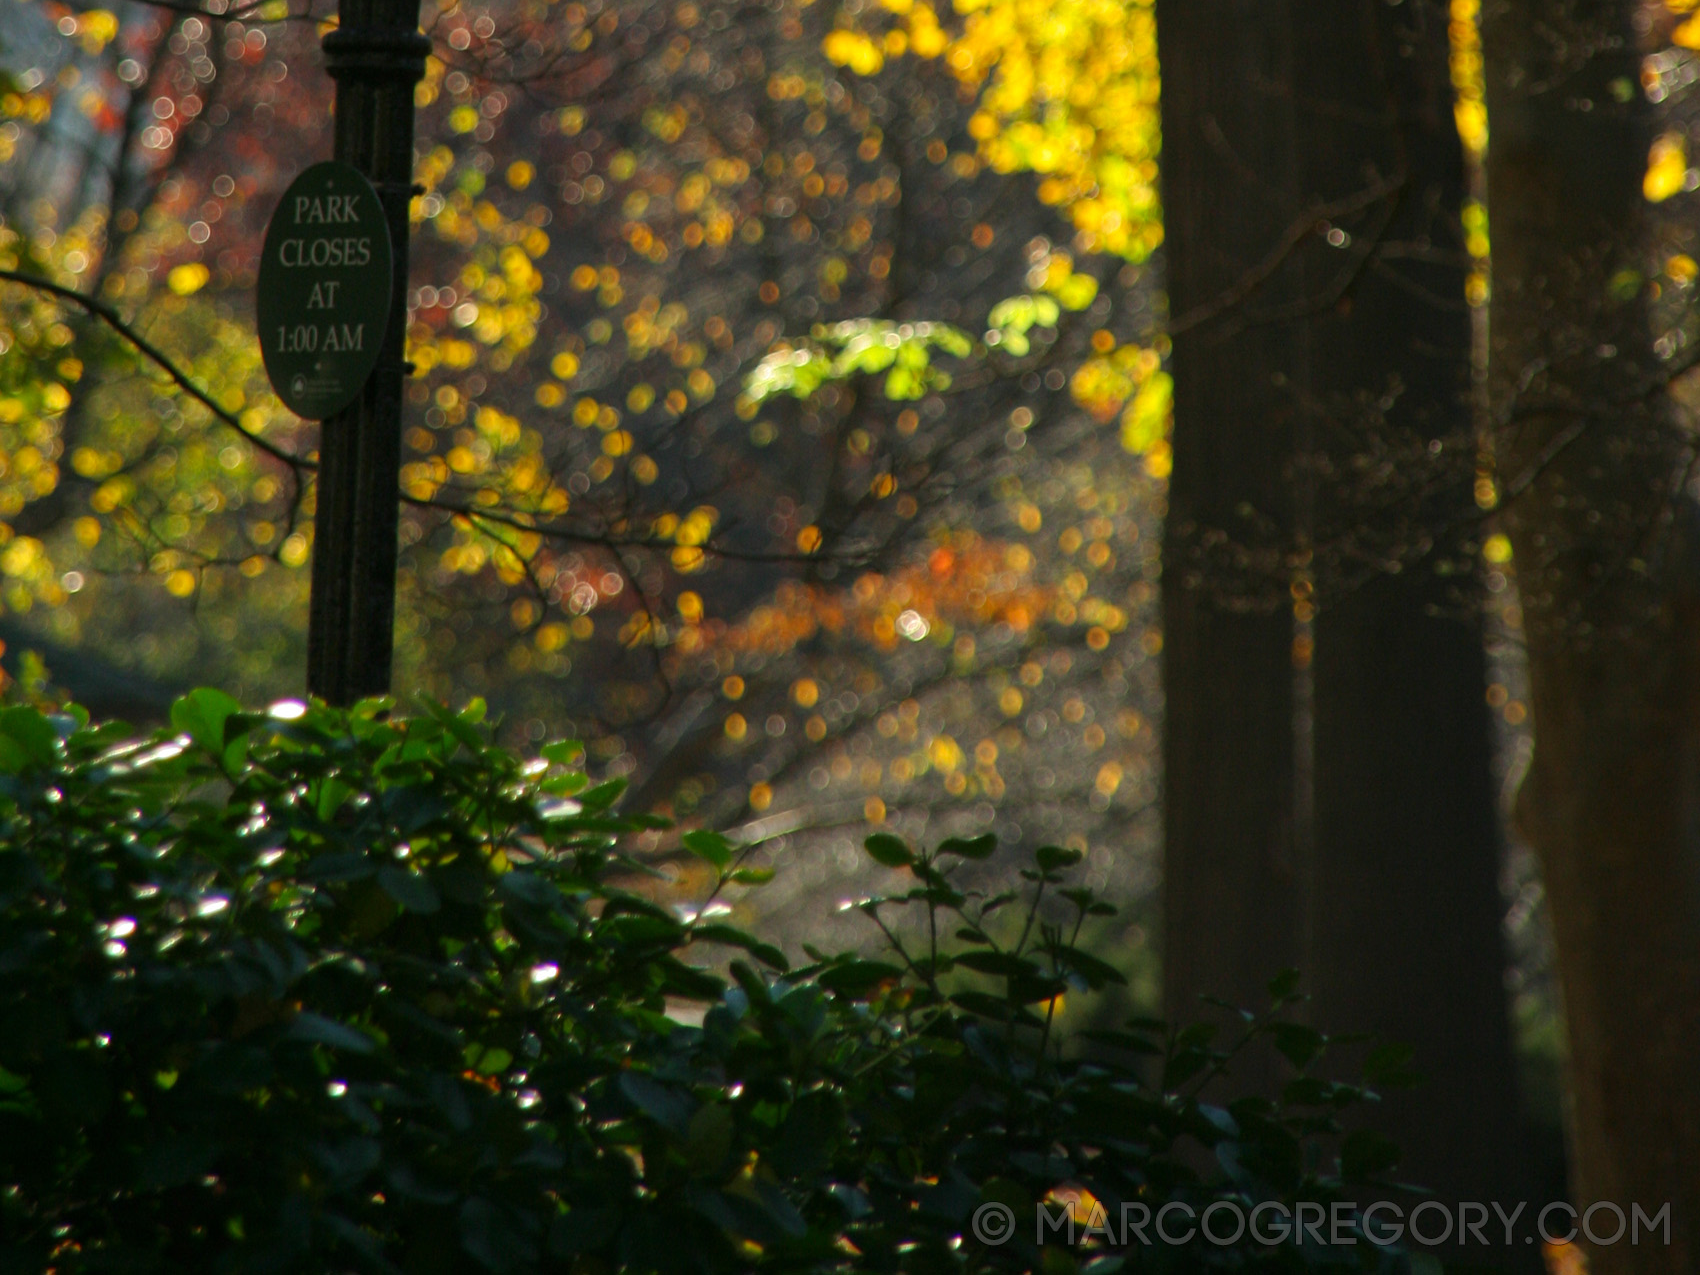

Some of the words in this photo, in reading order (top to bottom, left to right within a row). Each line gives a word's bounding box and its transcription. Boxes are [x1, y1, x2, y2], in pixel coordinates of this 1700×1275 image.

[294, 195, 360, 224] PARK
[279, 238, 371, 267] CLOSES
[307, 281, 340, 309] AT
[277, 325, 318, 352] 1:00
[322, 324, 363, 352] AM
